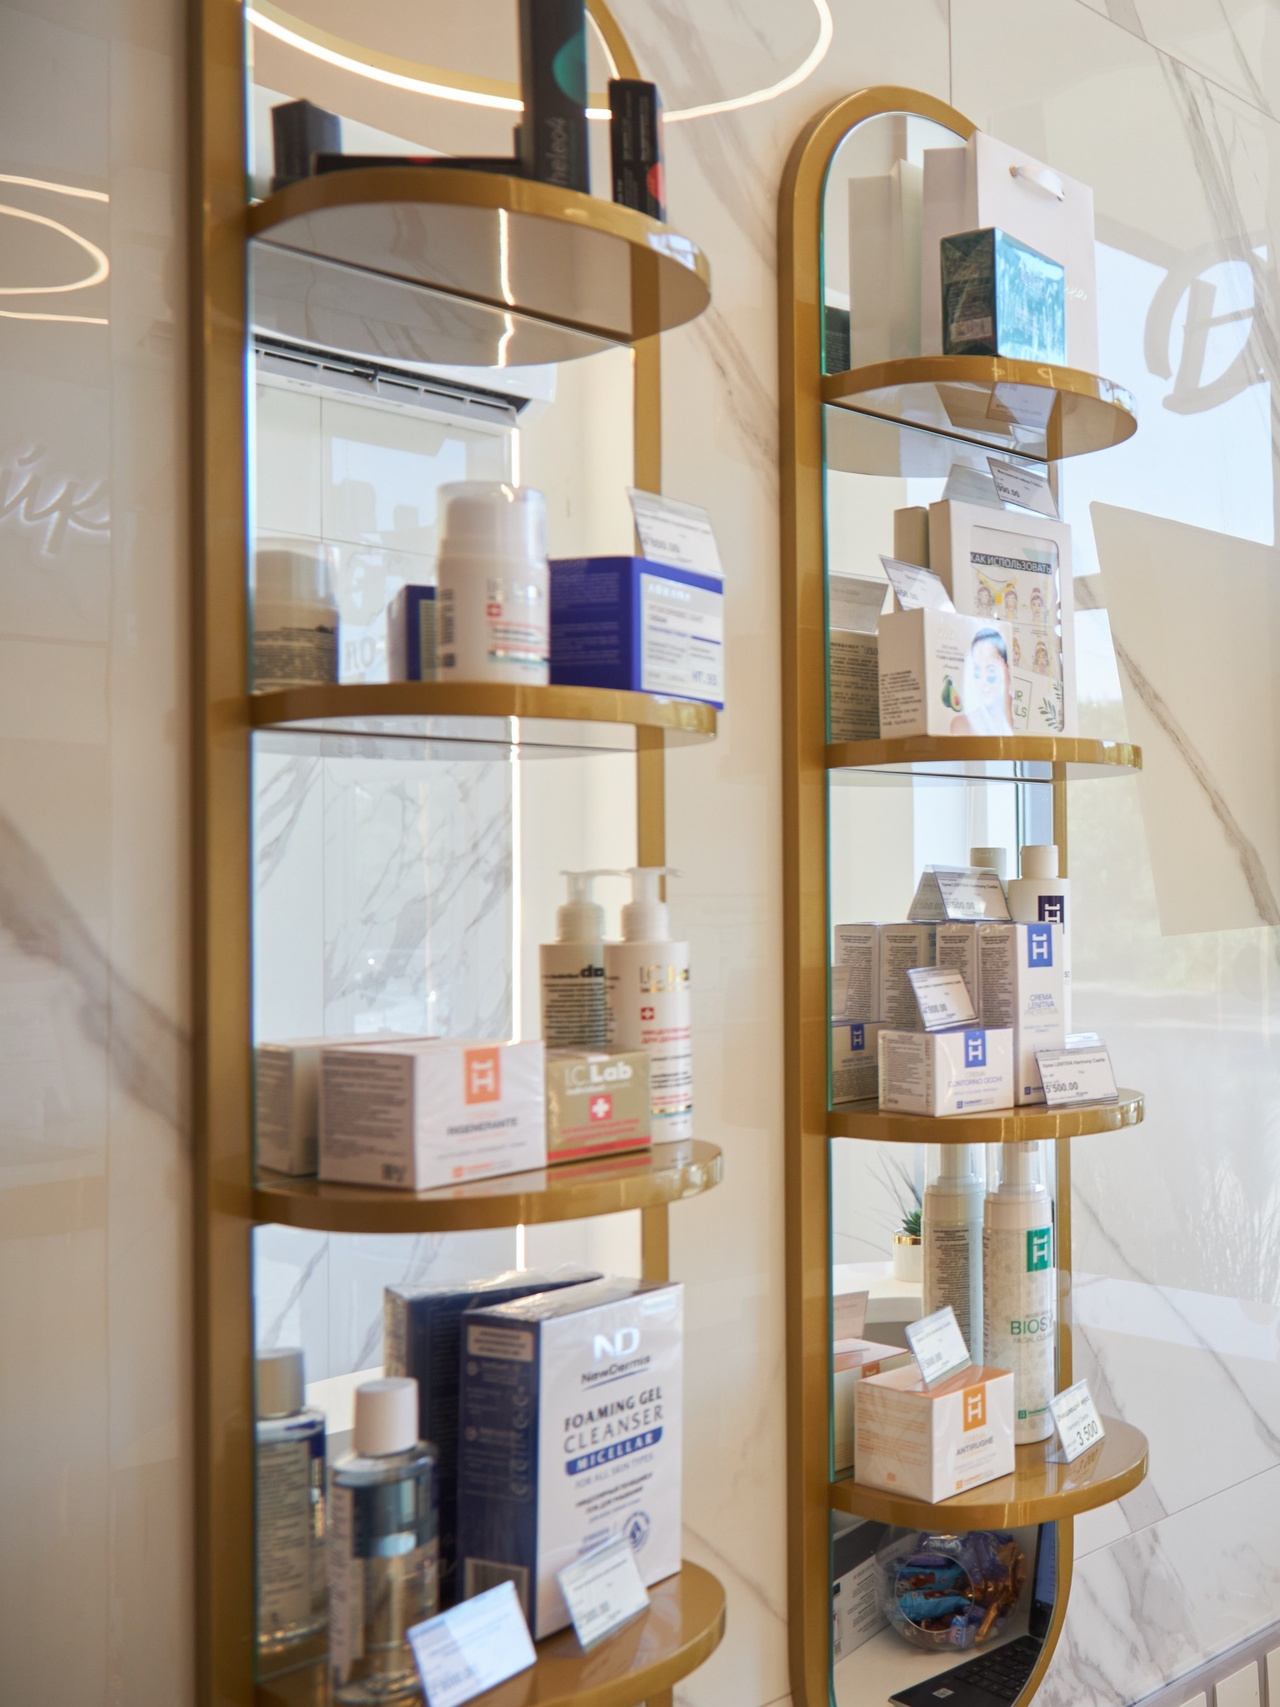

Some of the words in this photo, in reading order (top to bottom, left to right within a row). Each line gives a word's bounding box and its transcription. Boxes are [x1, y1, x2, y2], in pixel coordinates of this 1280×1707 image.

[987, 556, 1052, 575] ИСПОЛЬЗОВАТЬ
[1045, 1081, 1079, 1094] 5'500.00
[564, 1394, 636, 1432] FOAMING
[639, 1385, 663, 1406] GEL
[563, 1404, 664, 1454] CLEANSER
[575, 1432, 654, 1473] MICELLAR
[956, 1435, 994, 1457] ANTIRUGHE
